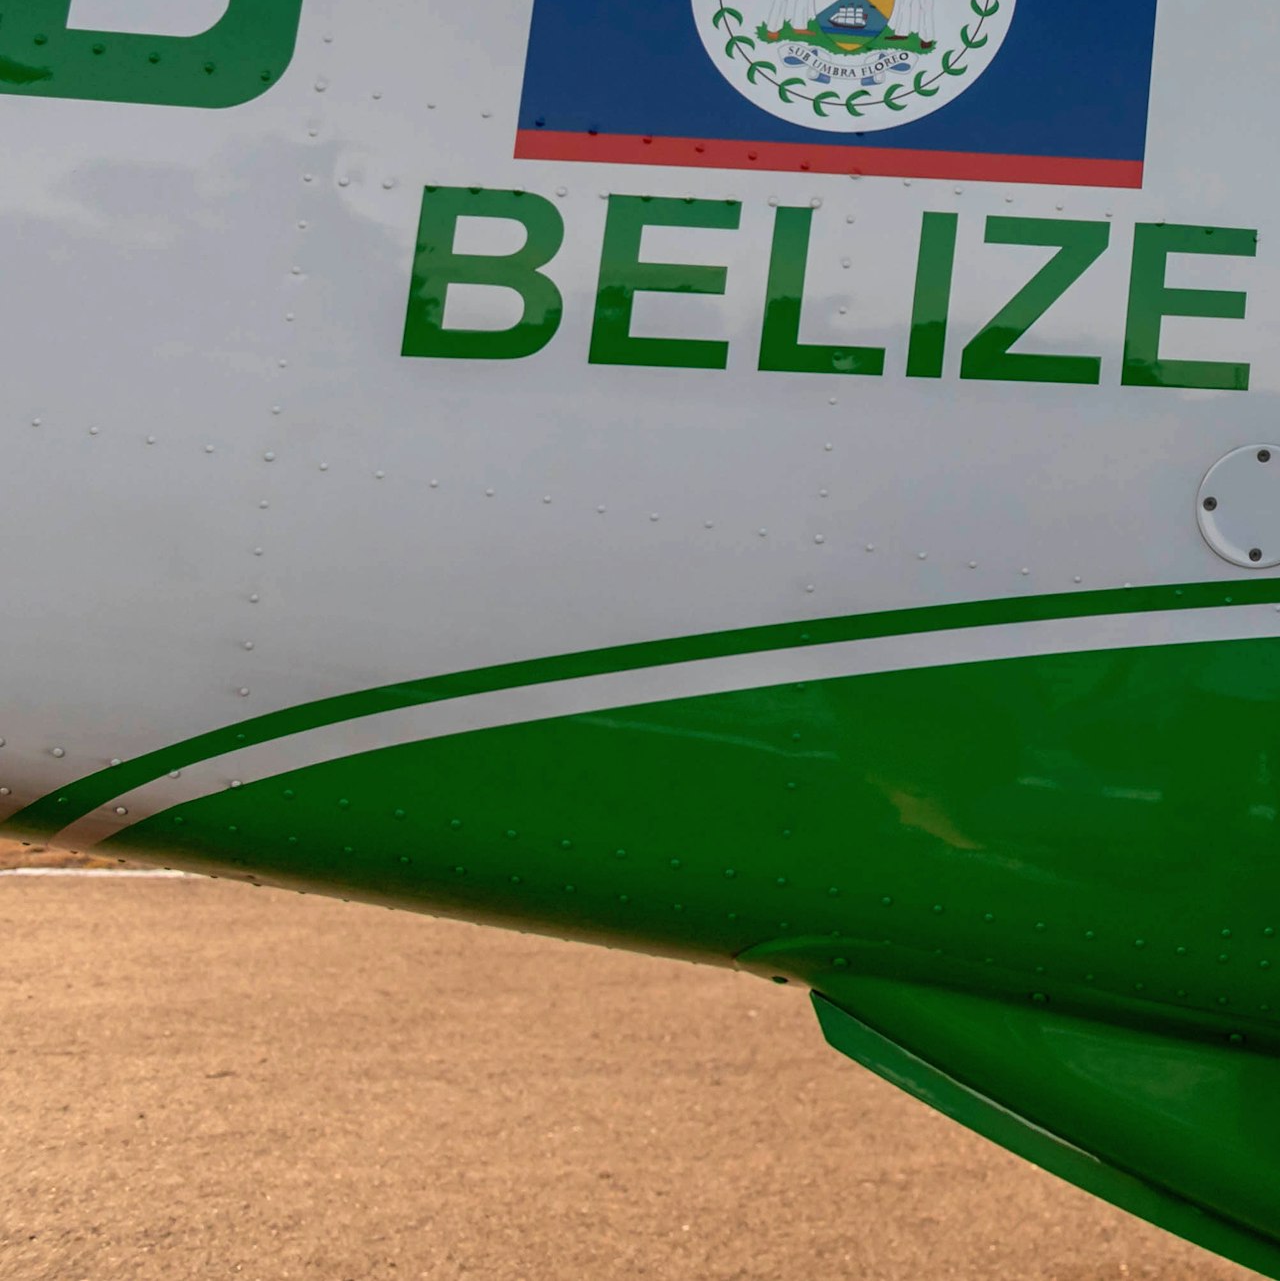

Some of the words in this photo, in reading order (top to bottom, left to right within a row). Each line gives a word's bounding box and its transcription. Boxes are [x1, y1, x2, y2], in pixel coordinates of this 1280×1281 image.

[788, 45, 812, 62] SUB
[812, 59, 857, 78] UMBRA
[861, 52, 910, 77] FLOREO
[401, 185, 1257, 390] BELIZE
